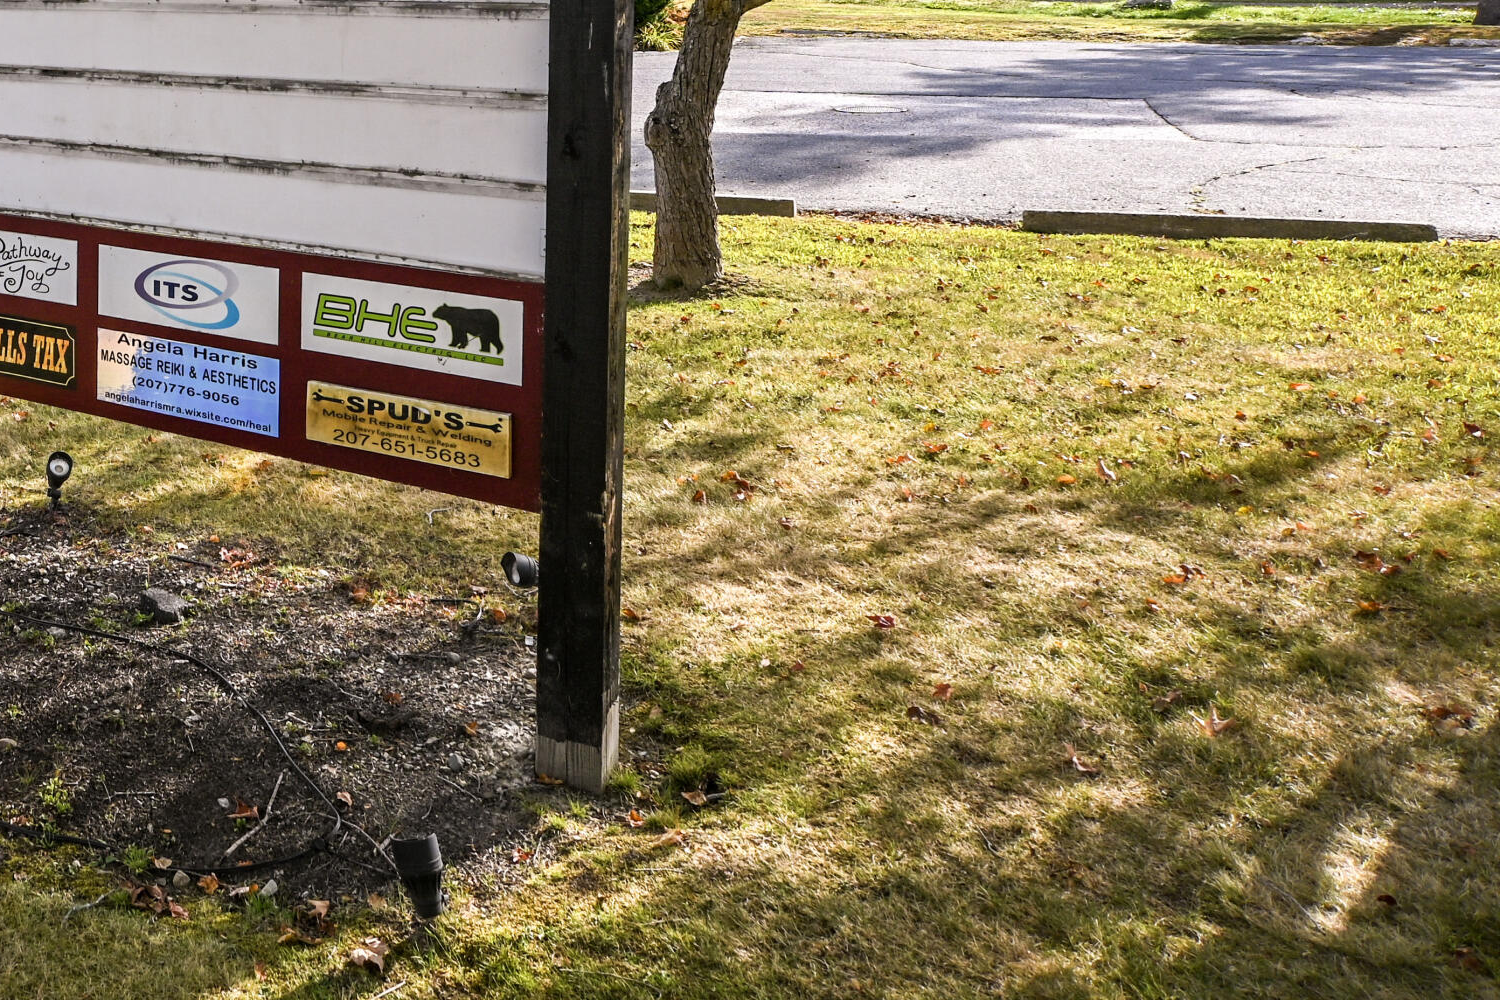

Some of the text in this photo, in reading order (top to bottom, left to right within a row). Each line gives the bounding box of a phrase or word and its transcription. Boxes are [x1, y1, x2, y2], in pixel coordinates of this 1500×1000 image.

[4, 265, 50, 293] Joy
[153, 279, 199, 302] ITS
[313, 292, 439, 344] BHE
[32, 334, 70, 374] TAX
[117, 333, 258, 370] Angela Harris
[100, 349, 276, 394] MASSAGE REIKI & AESTHETICS
[132, 375, 240, 406] (207)776-9056
[104, 390, 271, 433] angelaharrismra.wixsite.com/heal
[322, 408, 492, 447] Mobile Repair & Welding
[346, 395, 465, 431] SPUD'S
[333, 428, 481, 468] 207-651-5683
[354, 425, 376, 435] Heavy
[377, 429, 409, 440] Equipment
[417, 436, 435, 445] Truck
[436, 439, 457, 449] Repair
